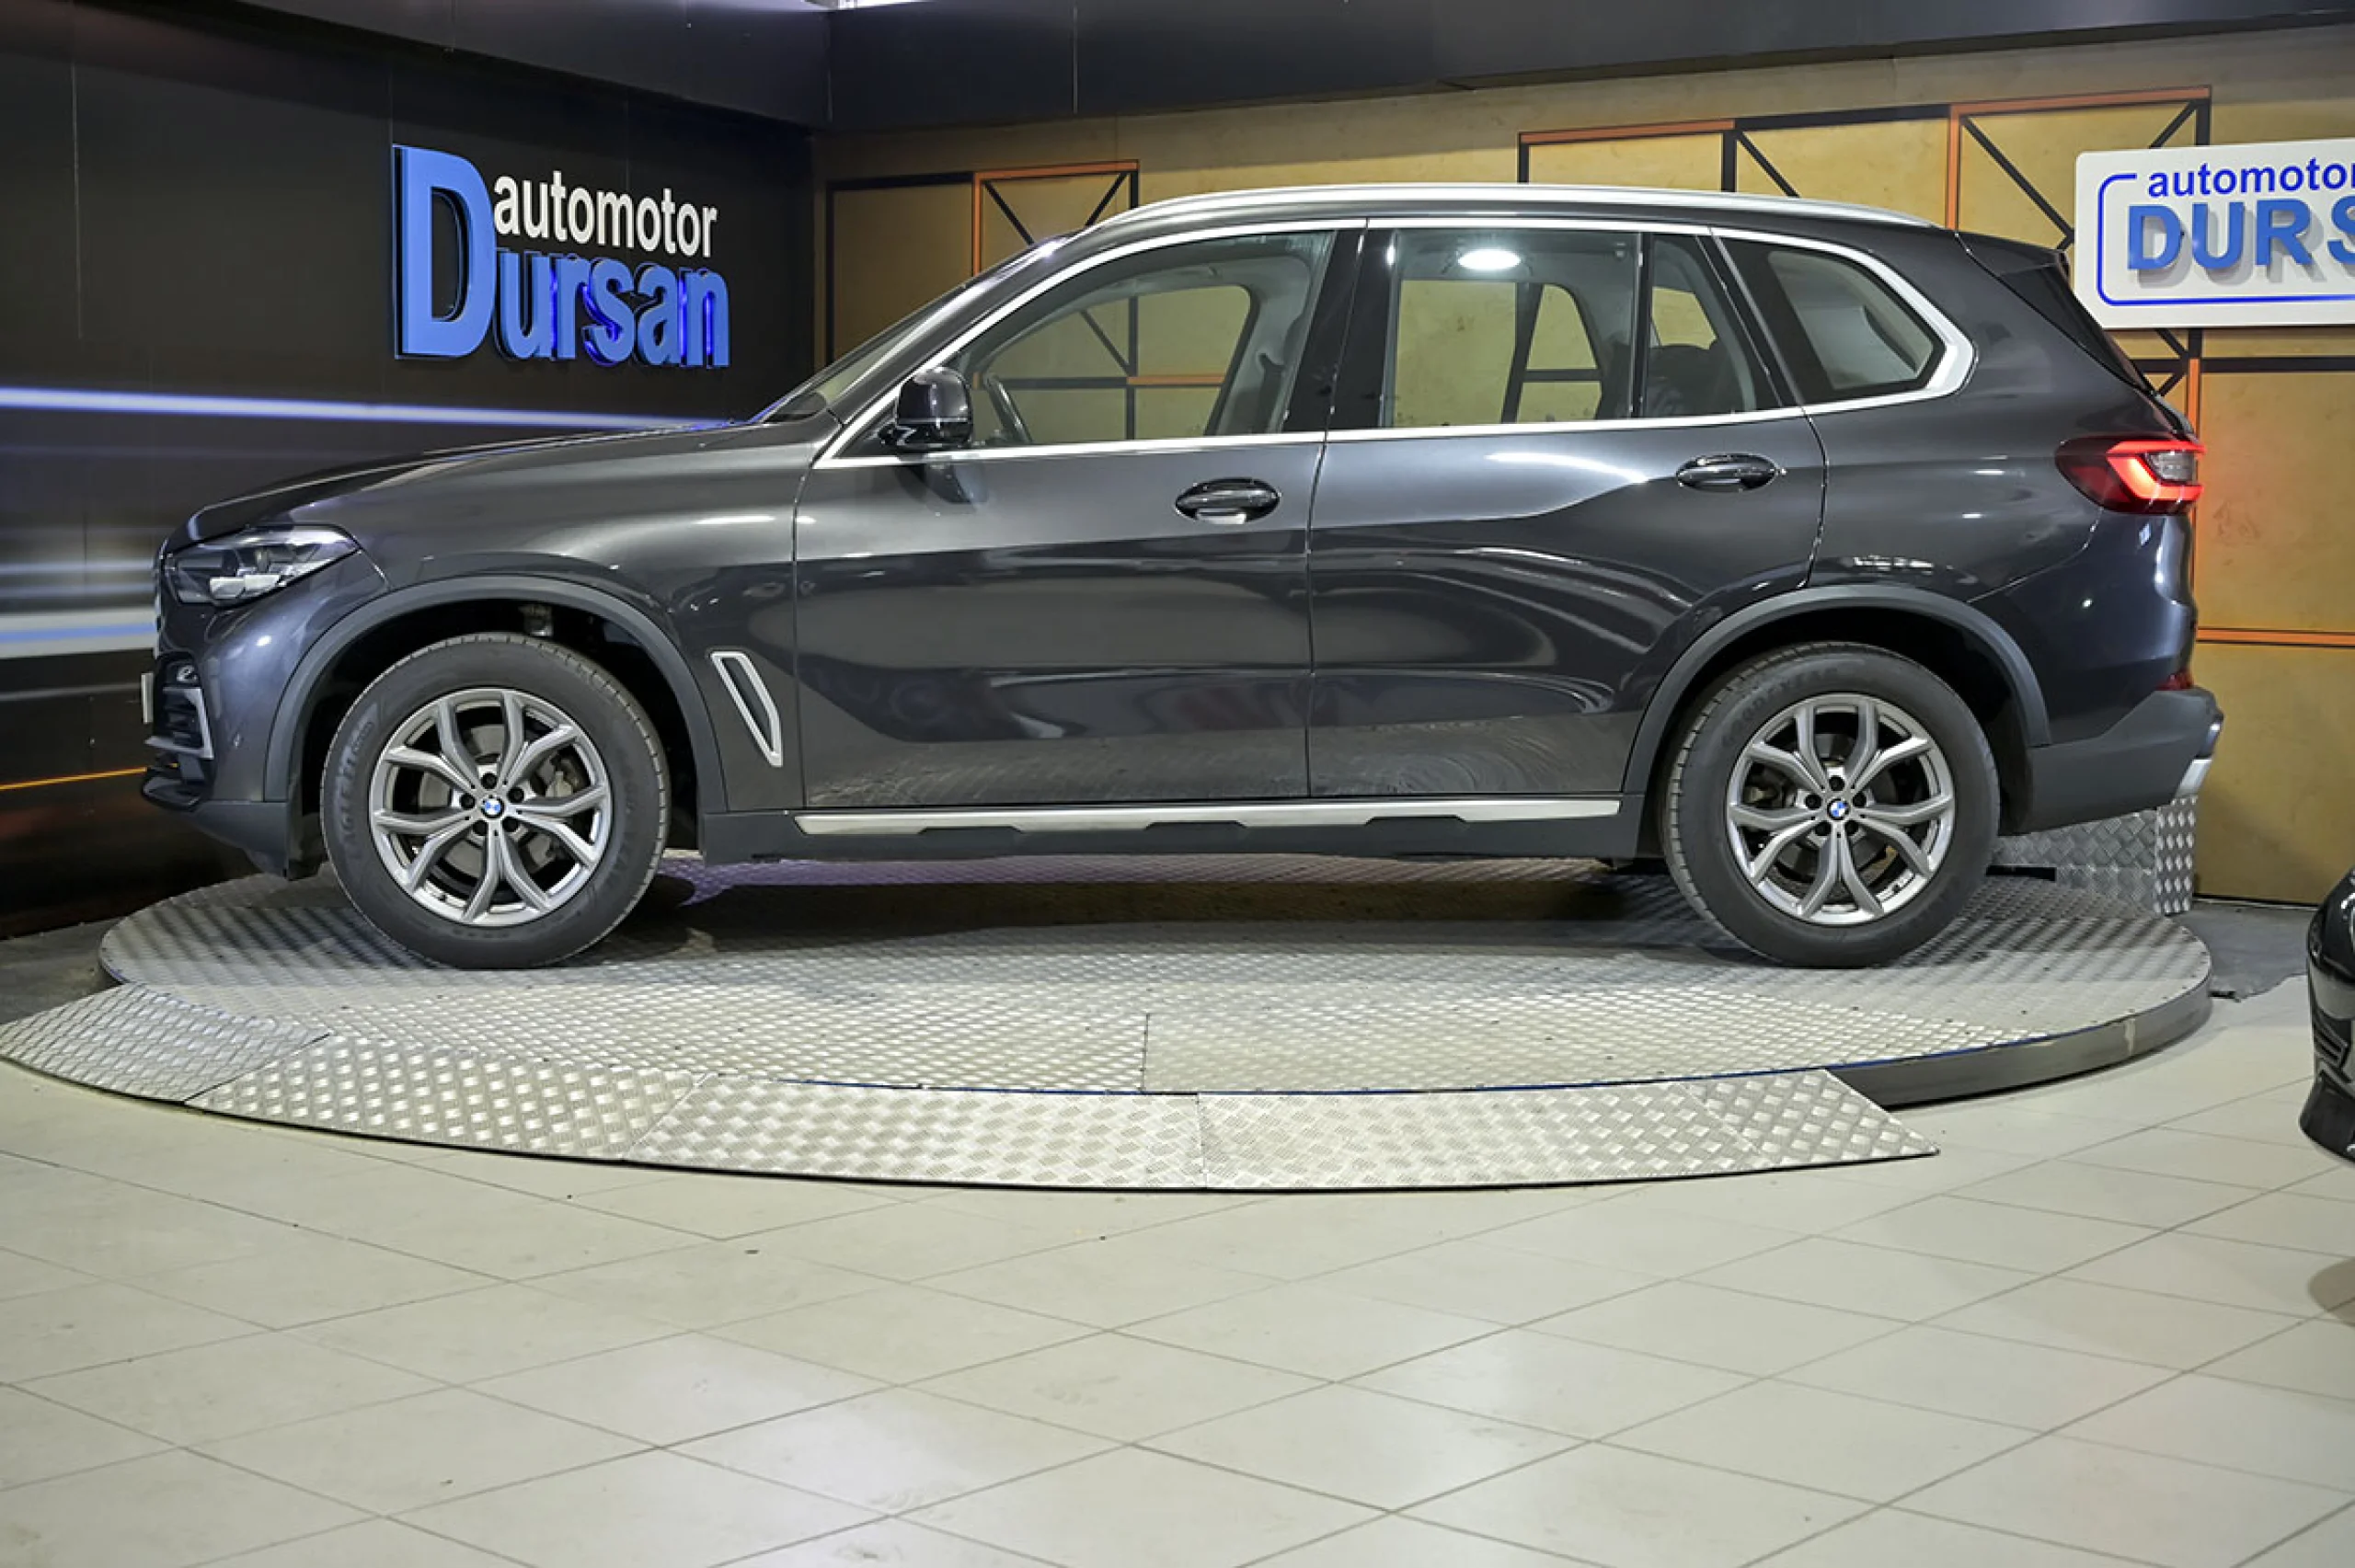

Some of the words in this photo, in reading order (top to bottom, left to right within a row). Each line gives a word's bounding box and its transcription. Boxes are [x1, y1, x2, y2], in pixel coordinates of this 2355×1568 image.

[493, 170, 718, 258] automotor
[2148, 156, 2355, 197] automoto
[392, 143, 731, 368] Dursan
